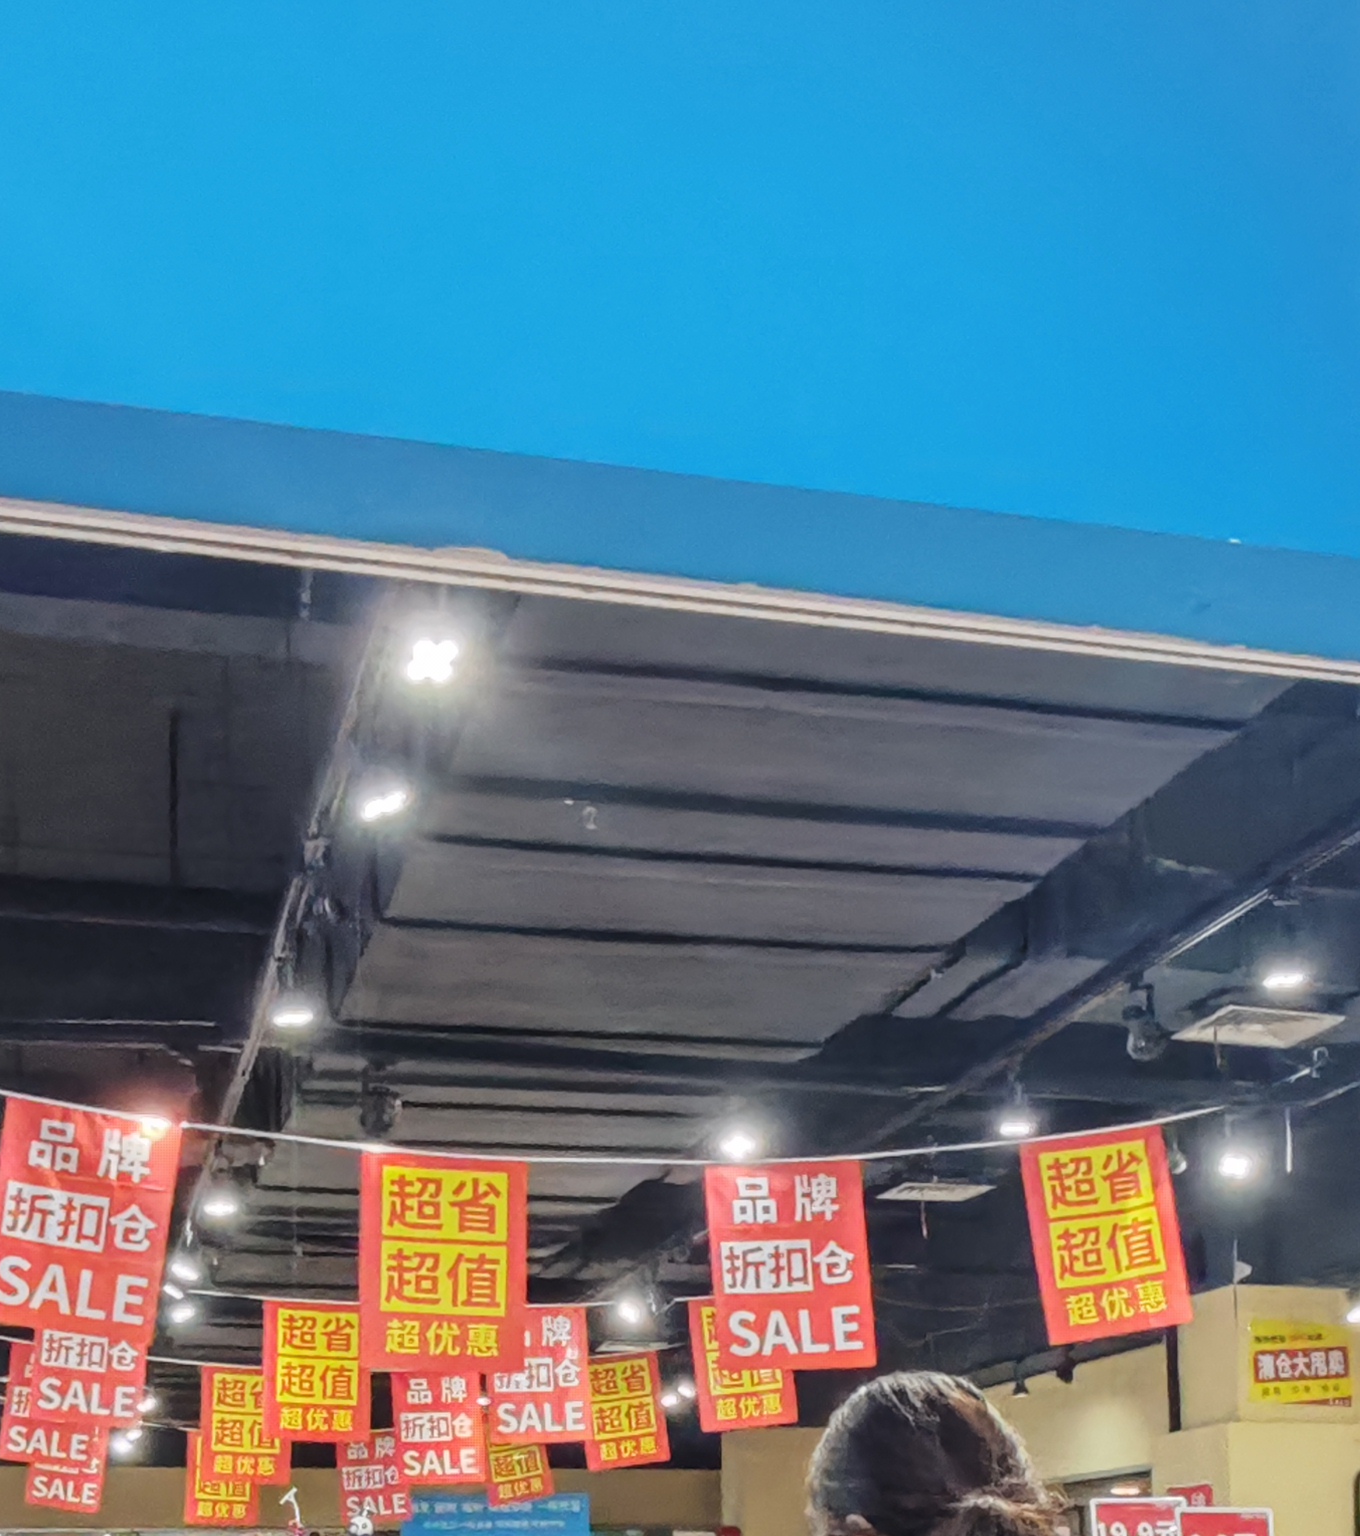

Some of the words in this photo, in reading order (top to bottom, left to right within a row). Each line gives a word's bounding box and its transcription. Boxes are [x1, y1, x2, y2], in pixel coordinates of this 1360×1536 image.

[27, 1118, 152, 1184] 品牌
[1046, 1148, 1143, 1210] 超省
[387, 1174, 502, 1234] 超省
[732, 1173, 839, 1224] 品牌
[5, 1187, 158, 1252] 折扣仓
[724, 1241, 855, 1290] 折扣仓
[1056, 1218, 1161, 1281] 超值
[384, 1248, 502, 1309] 超值
[1065, 1280, 1168, 1327] 超优惠
[280, 1314, 356, 1353] 超省
[385, 1319, 500, 1357] 超优惠
[728, 1304, 865, 1357] SALE
[43, 1332, 139, 1373] 折扣仓
[1257, 1350, 1345, 1380] 清仓大甩卖
[36, 1376, 137, 1418] SALE
[280, 1362, 355, 1401] 超值
[406, 1375, 468, 1405] 品牌
[589, 1363, 646, 1396] 超省
[279, 1407, 354, 1432] 超优惠
[402, 1412, 474, 1441] 折扣仓
[497, 1400, 586, 1434] SALE
[595, 1401, 655, 1435] 超值
[716, 1394, 783, 1421] 超优惠
[7, 1425, 90, 1461] SALE
[600, 1436, 657, 1461] 超优惠
[213, 1454, 276, 1476] 超优惠
[402, 1448, 480, 1477] SALE
[31, 1475, 99, 1505] SALE
[346, 1492, 407, 1516] SALE
